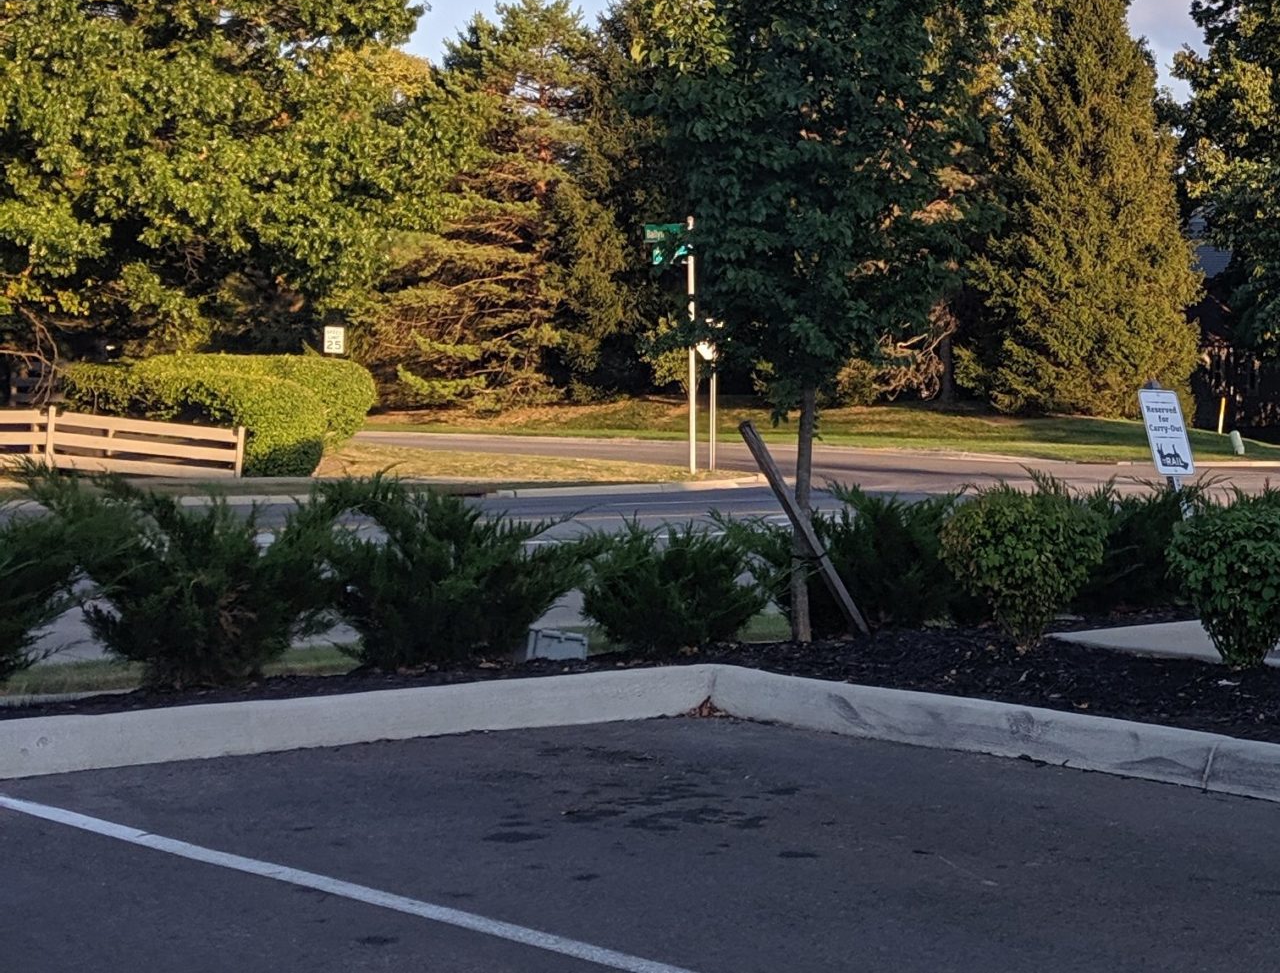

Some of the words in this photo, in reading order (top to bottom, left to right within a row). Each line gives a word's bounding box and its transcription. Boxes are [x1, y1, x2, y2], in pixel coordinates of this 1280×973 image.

[326, 340, 342, 350] 25
[1145, 405, 1177, 414] Reserved
[1158, 415, 1169, 423] for
[1149, 424, 1183, 434] Carry-Out
[1166, 456, 1185, 466] RAIL
